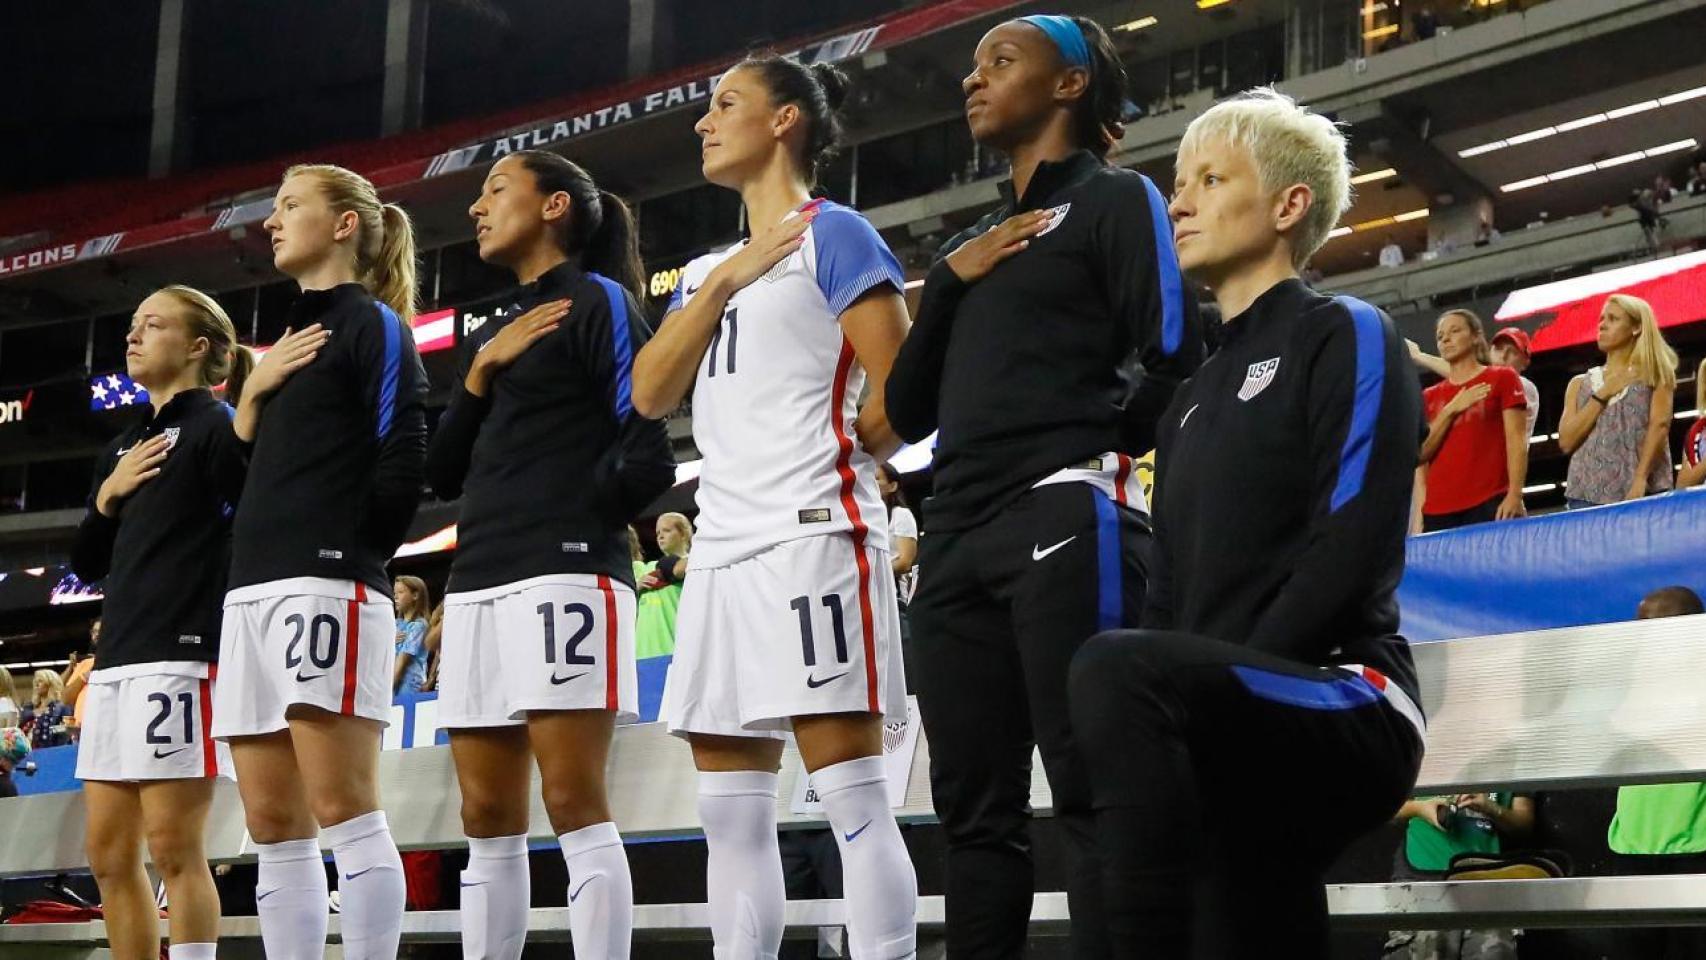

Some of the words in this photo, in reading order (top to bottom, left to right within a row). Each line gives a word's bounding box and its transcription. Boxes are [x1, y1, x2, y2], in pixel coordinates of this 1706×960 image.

[492, 102, 632, 157] ATLANTA
[650, 267, 685, 297] 690
[1249, 360, 1277, 379] USA
[284, 613, 340, 669] 20
[536, 601, 595, 665] 12
[790, 593, 848, 666] 11
[146, 691, 193, 744] 21
